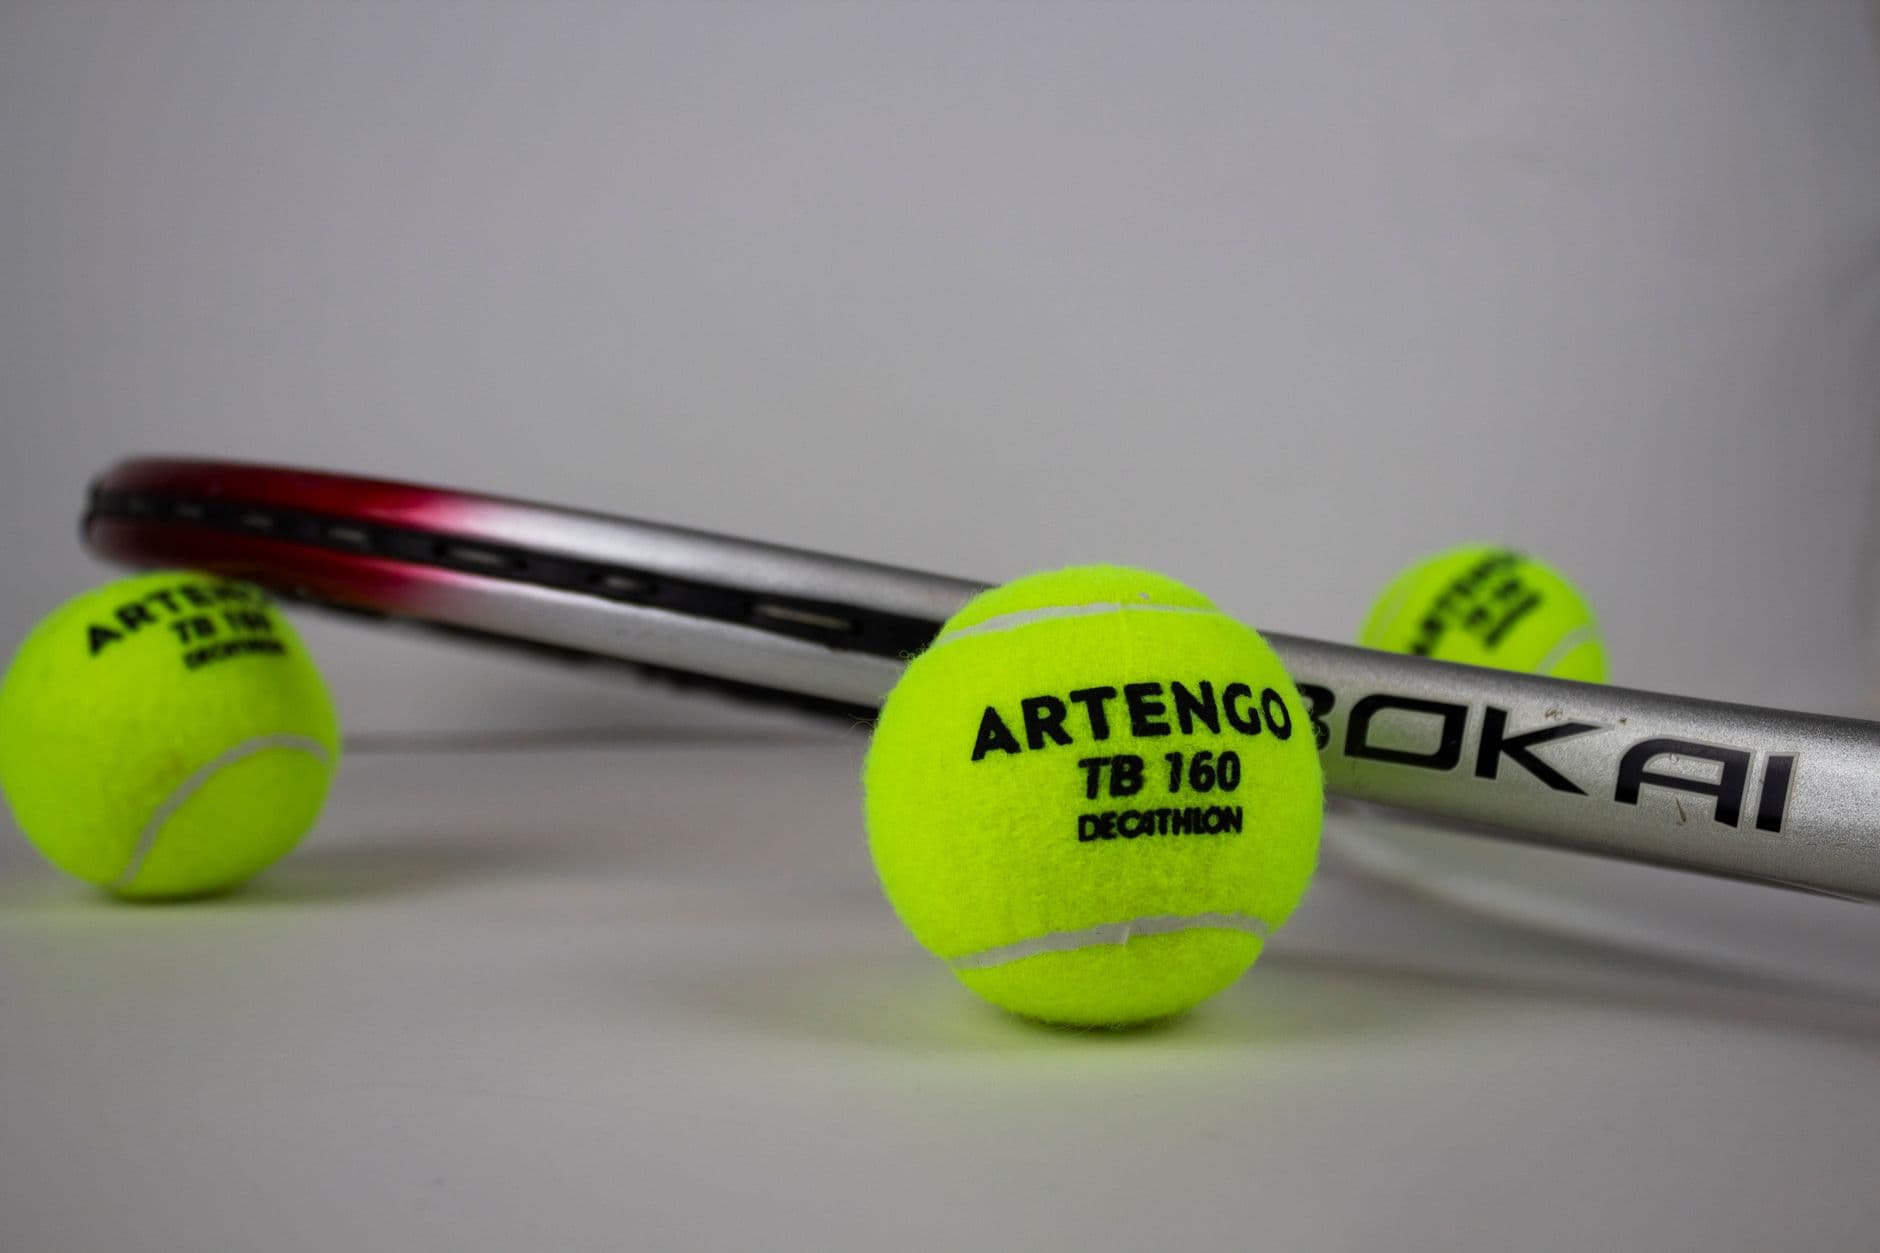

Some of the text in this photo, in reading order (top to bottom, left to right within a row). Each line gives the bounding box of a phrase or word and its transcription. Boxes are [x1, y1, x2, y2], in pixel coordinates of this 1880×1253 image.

[87, 582, 258, 656] ARTE
[971, 680, 1293, 762] ARTENGO
[1077, 750, 1242, 800] TB 160
[1077, 805, 1244, 843] DECATHLON
